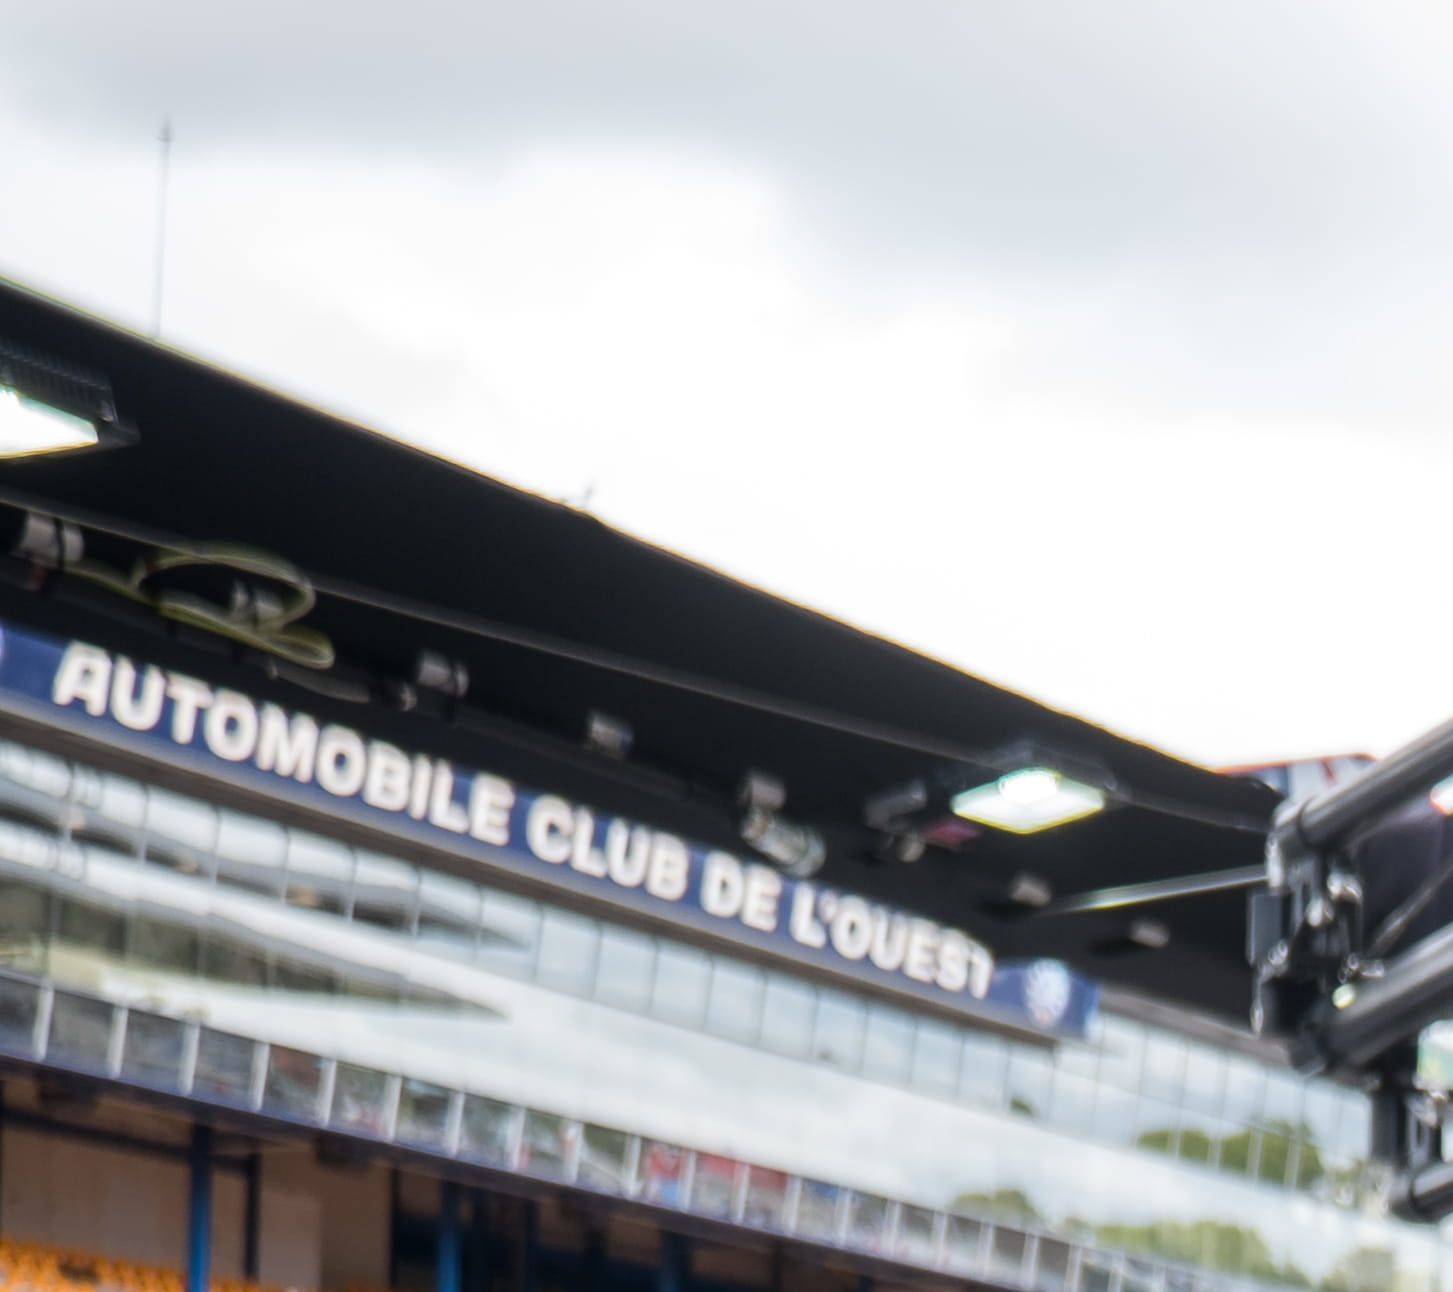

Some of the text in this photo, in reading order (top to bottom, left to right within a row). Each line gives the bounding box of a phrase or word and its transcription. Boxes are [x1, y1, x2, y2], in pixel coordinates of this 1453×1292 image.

[52, 639, 994, 1000] AUTOMOBILE CLUB DE L'OUEST
